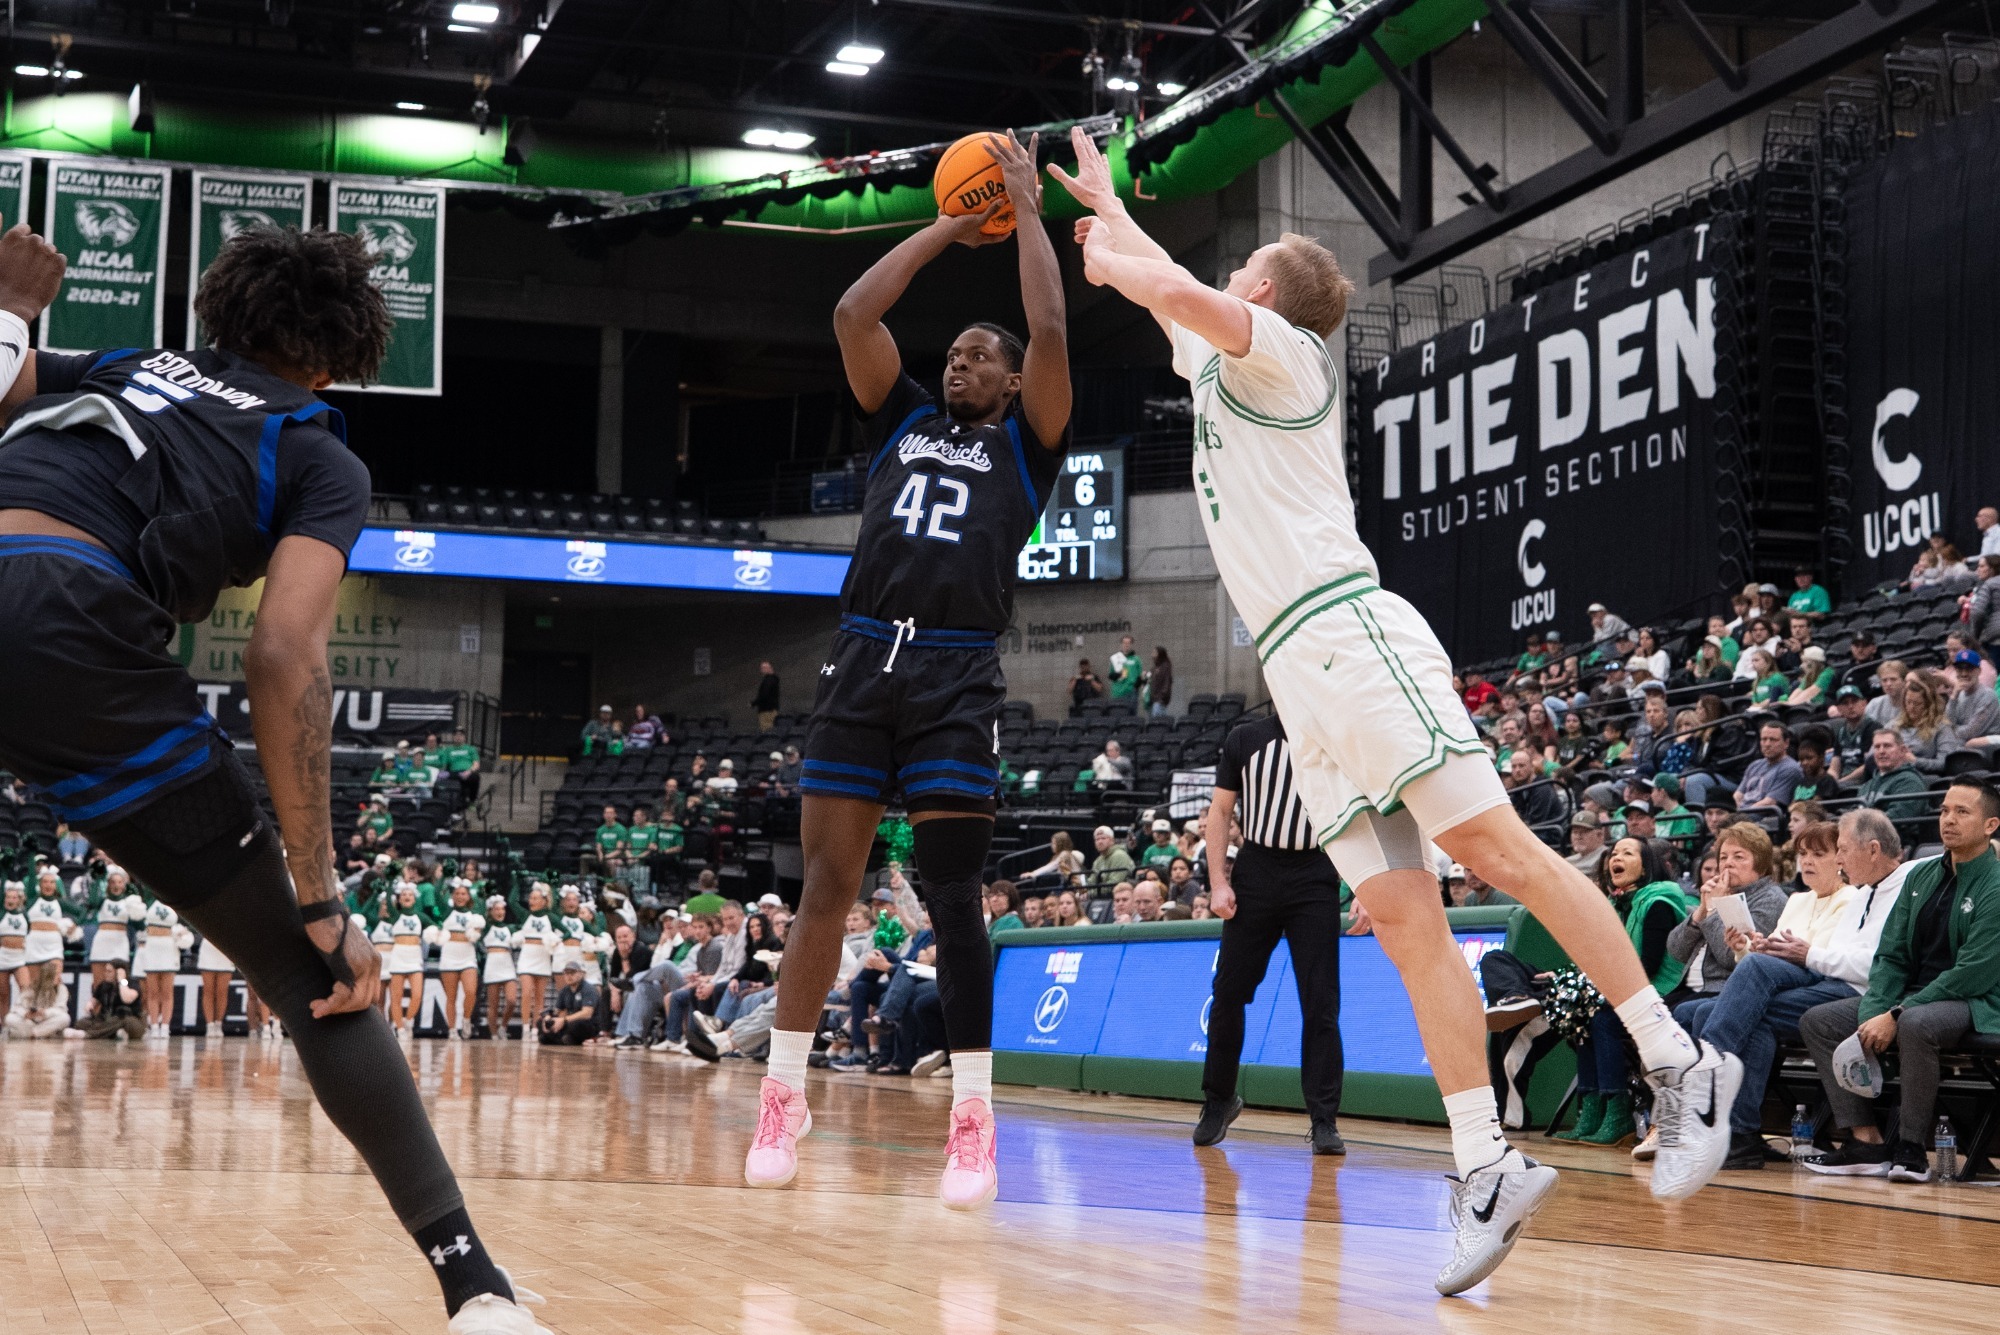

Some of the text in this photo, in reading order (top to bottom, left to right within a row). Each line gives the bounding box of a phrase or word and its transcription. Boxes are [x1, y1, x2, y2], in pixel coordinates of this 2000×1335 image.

[58, 171, 161, 190] UTAH VALLEY
[203, 181, 304, 199] UTAH VALLEY
[339, 191, 436, 209] UTAH VALLEY
[958, 180, 1005, 210] Wils
[77, 249, 134, 269] NCAA
[64, 267, 154, 284] OURNAMENT
[66, 286, 141, 306] 2020-21
[1377, 223, 1710, 391] PROTECT
[1373, 277, 1717, 499] THE DEN
[898, 433, 991, 468] Mavericks
[1067, 454, 1103, 473] UTA
[1075, 474, 1095, 506] 6
[1402, 425, 1687, 541] STUDENT SECTION
[891, 472, 970, 543] 42
[1093, 510, 1110, 525] 01
[1060, 512, 1071, 526] 4
[1863, 491, 1941, 558] UCCU
[1092, 525, 1116, 540] FLS
[211, 609, 256, 629] UTA
[1511, 588, 1555, 631] UCCU
[1027, 619, 1131, 636] Intermountain
[1236, 630, 1249, 643] 12
[1028, 638, 1072, 652] Health
